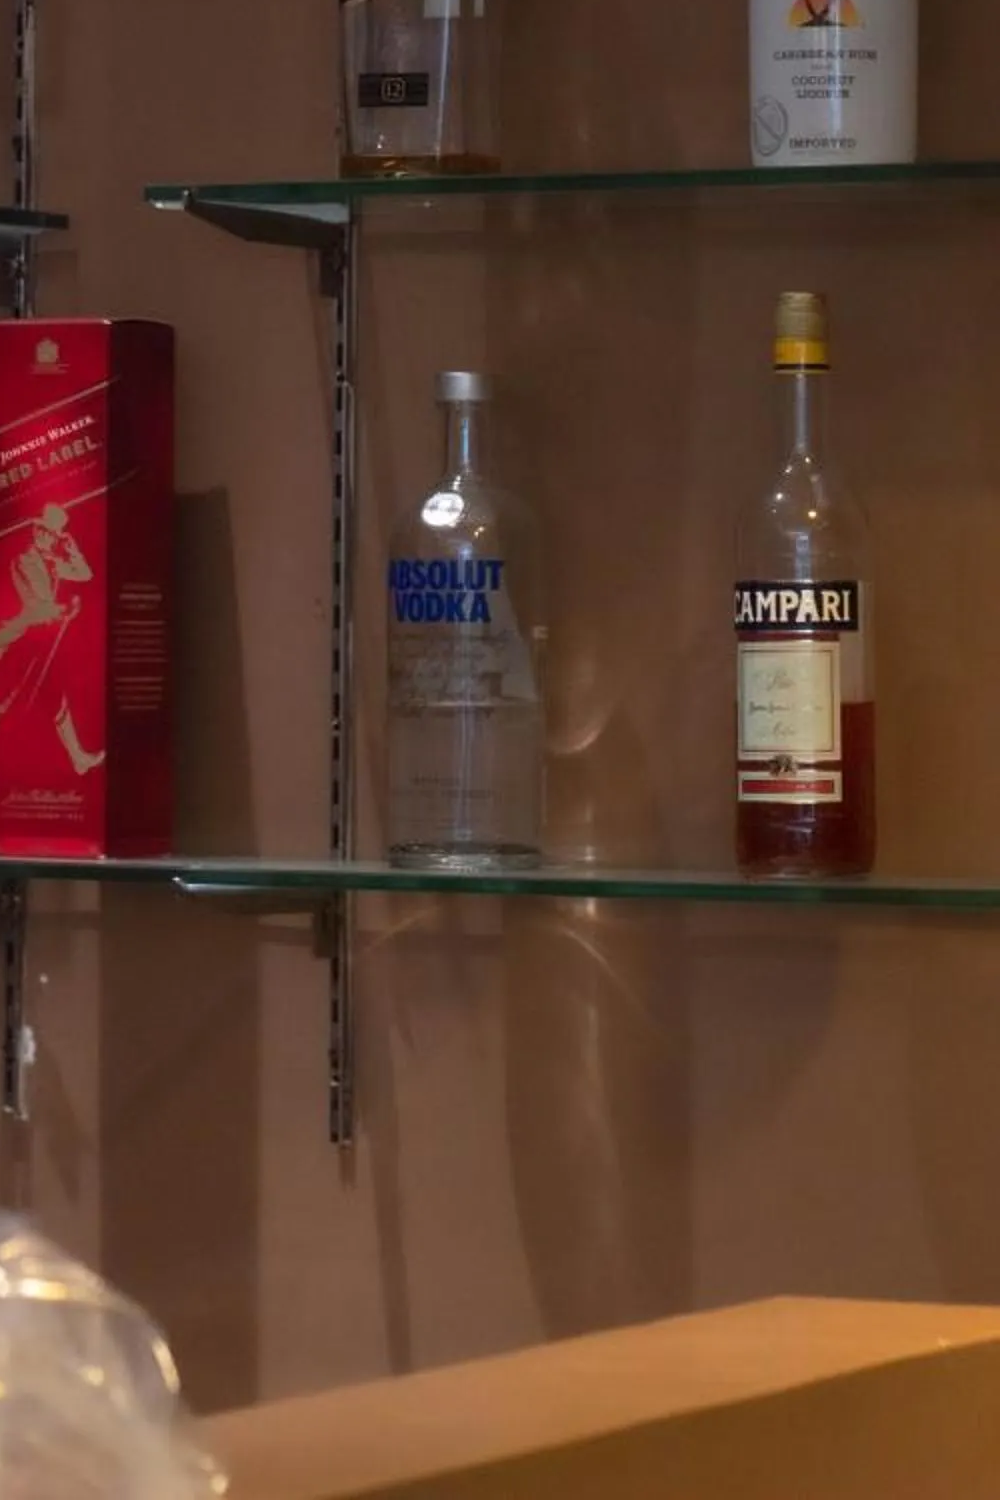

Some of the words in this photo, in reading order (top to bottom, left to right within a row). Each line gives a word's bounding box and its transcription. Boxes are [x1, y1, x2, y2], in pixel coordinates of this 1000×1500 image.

[791, 74, 856, 86] COCONUT
[789, 137, 857, 150] IMPORTED
[36, 435, 98, 472] LABEL
[395, 590, 491, 623] VODKA
